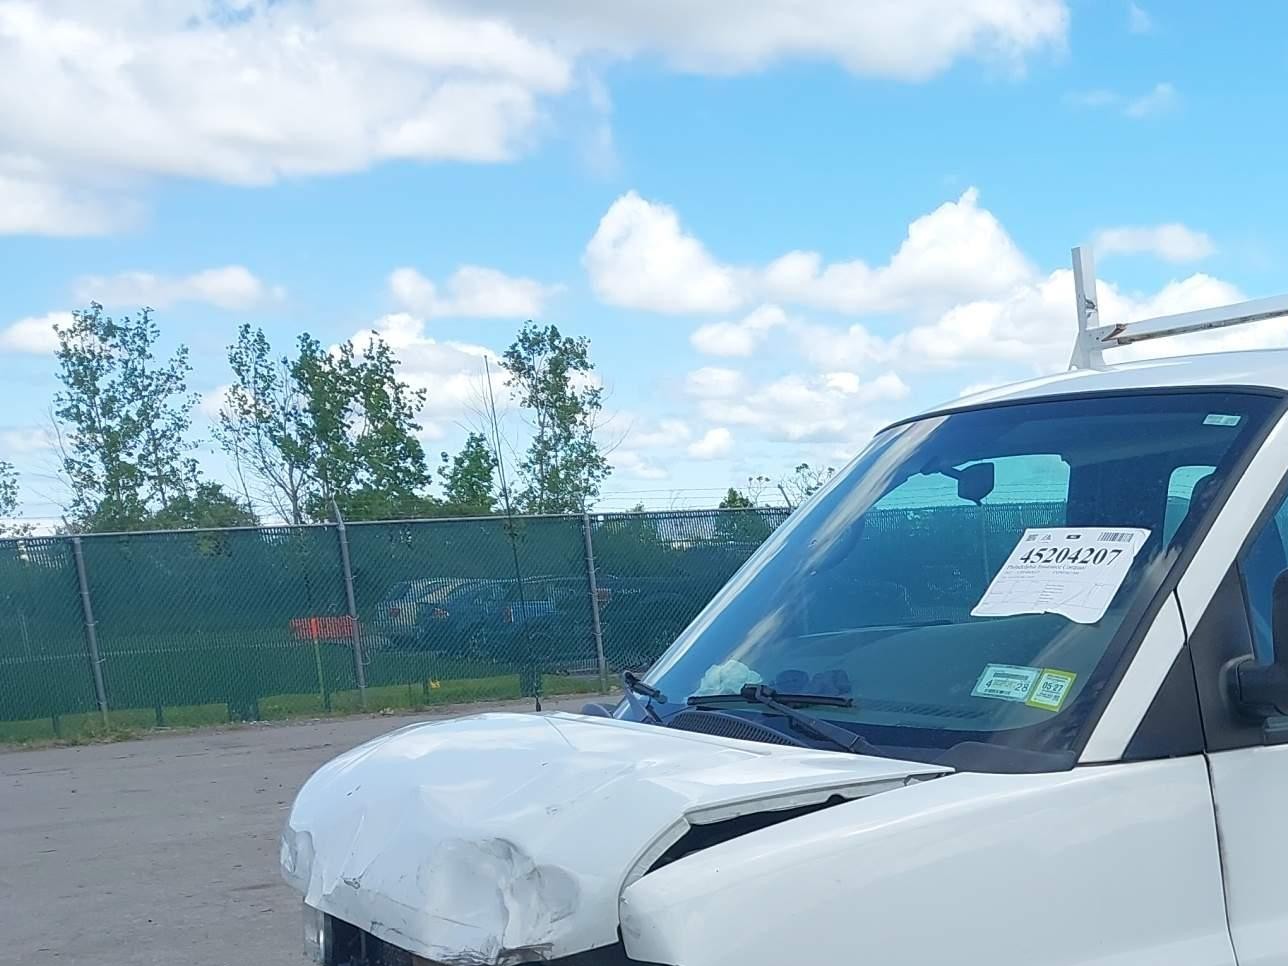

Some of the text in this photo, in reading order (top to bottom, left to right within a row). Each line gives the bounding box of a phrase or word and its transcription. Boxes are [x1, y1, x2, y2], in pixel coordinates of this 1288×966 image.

[1020, 547, 1123, 566] 45204207
[986, 680, 1029, 692] 4 28
